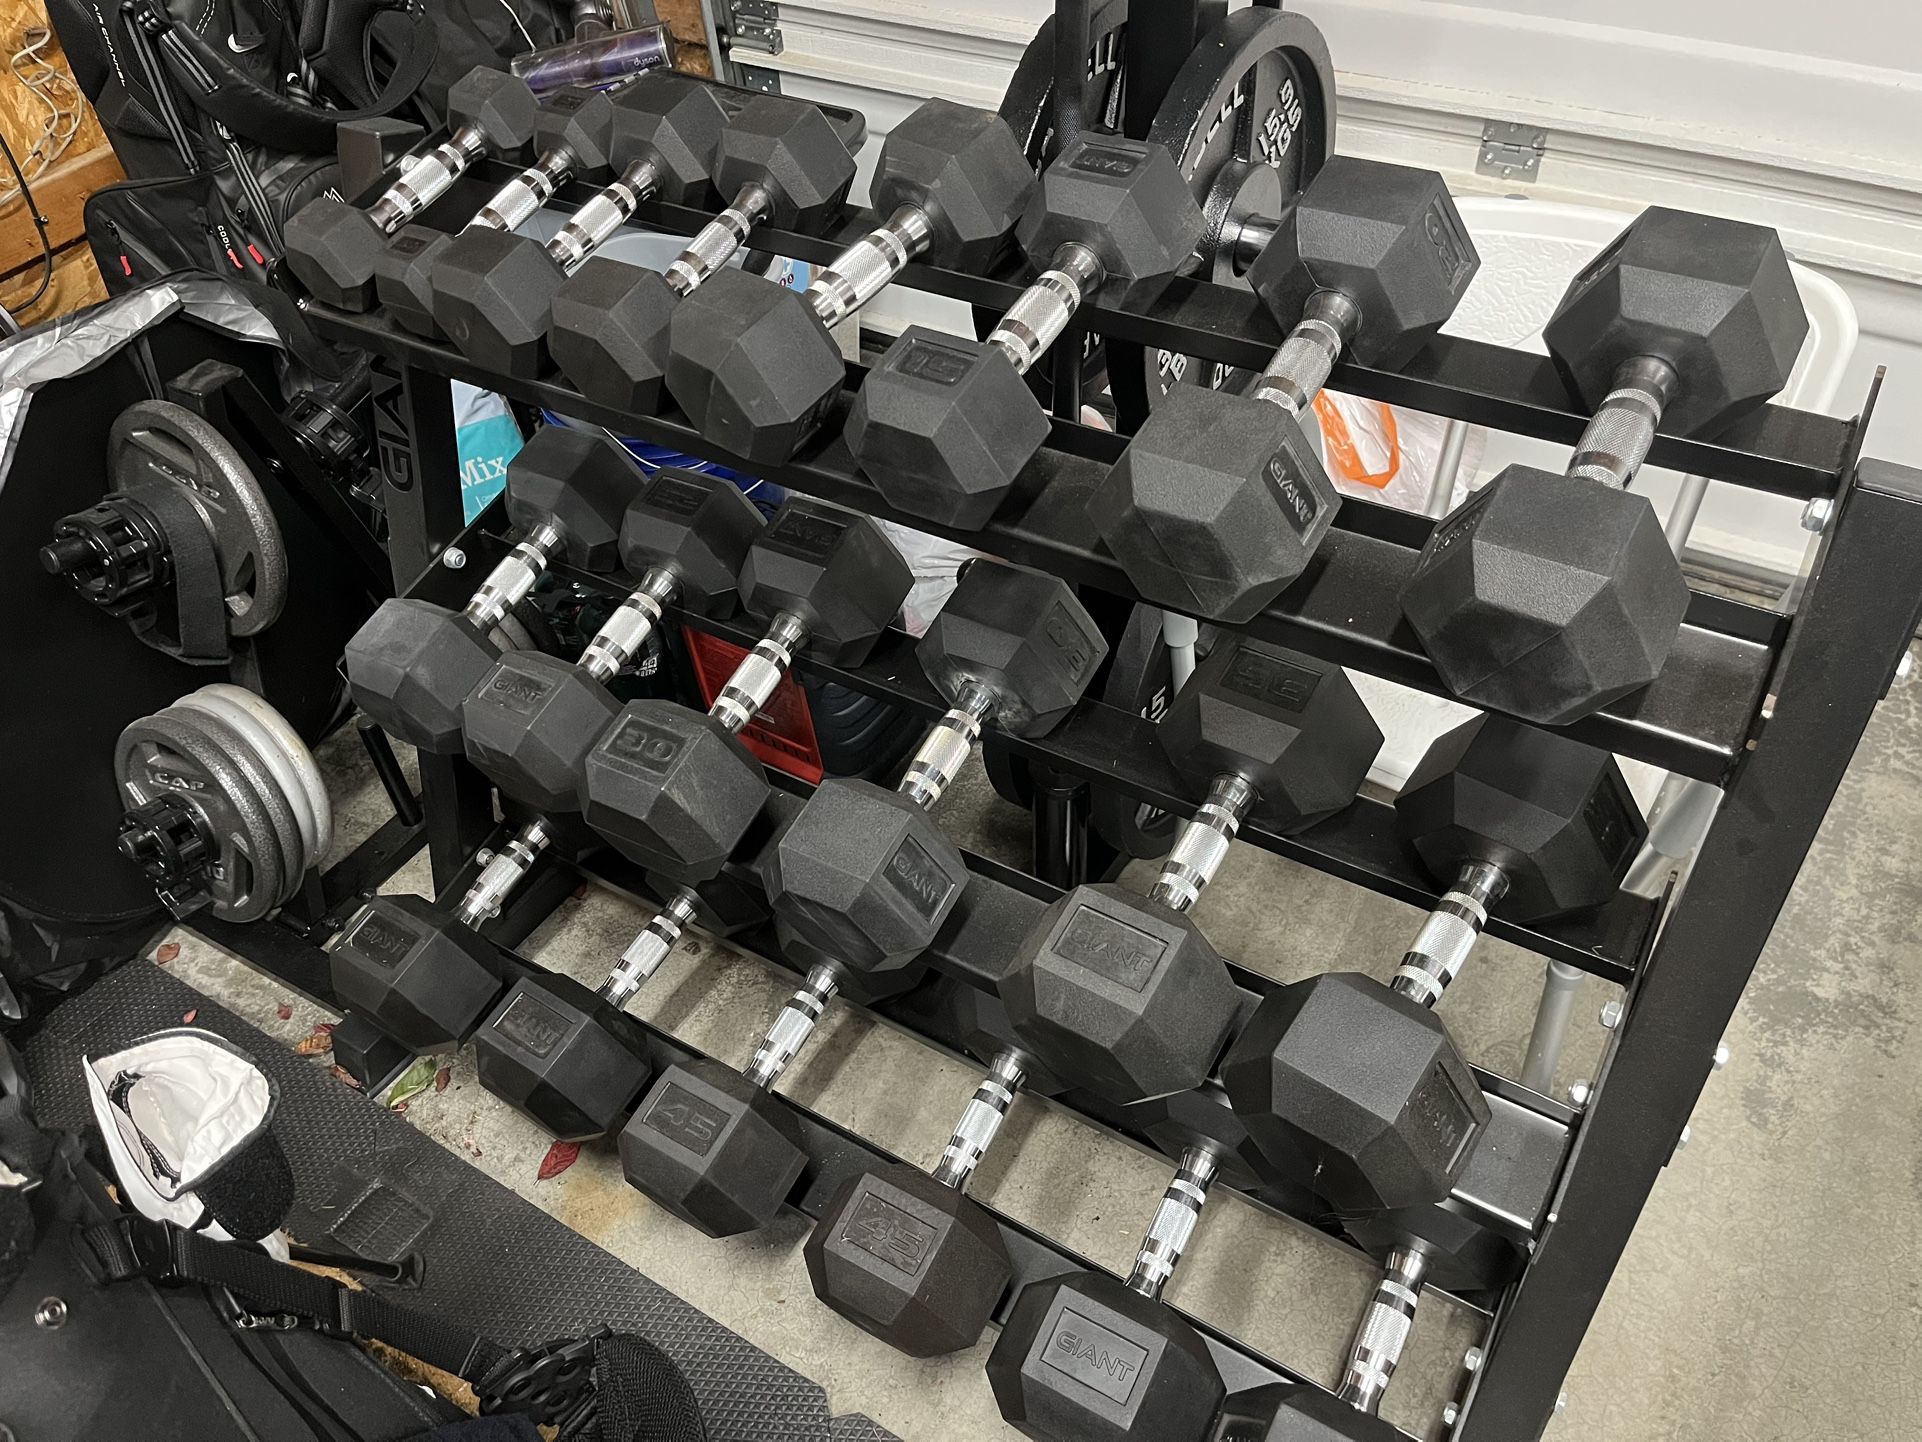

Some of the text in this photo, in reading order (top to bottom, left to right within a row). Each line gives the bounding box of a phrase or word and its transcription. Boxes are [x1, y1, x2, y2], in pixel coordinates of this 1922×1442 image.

[92, 3, 125, 87] AIR CHANNEL
[633, 54, 661, 68] dyson
[460, 456, 508, 490] Mix
[1269, 456, 1313, 523] GIANT
[491, 679, 544, 705] GIANT
[615, 727, 678, 763] 30
[153, 772, 206, 791] CAP
[892, 852, 942, 905] GIANT
[1069, 926, 1153, 974] GIANT
[657, 1103, 718, 1142] 45
[856, 1215, 926, 1260] 45
[1055, 1329, 1136, 1383] GIANT
